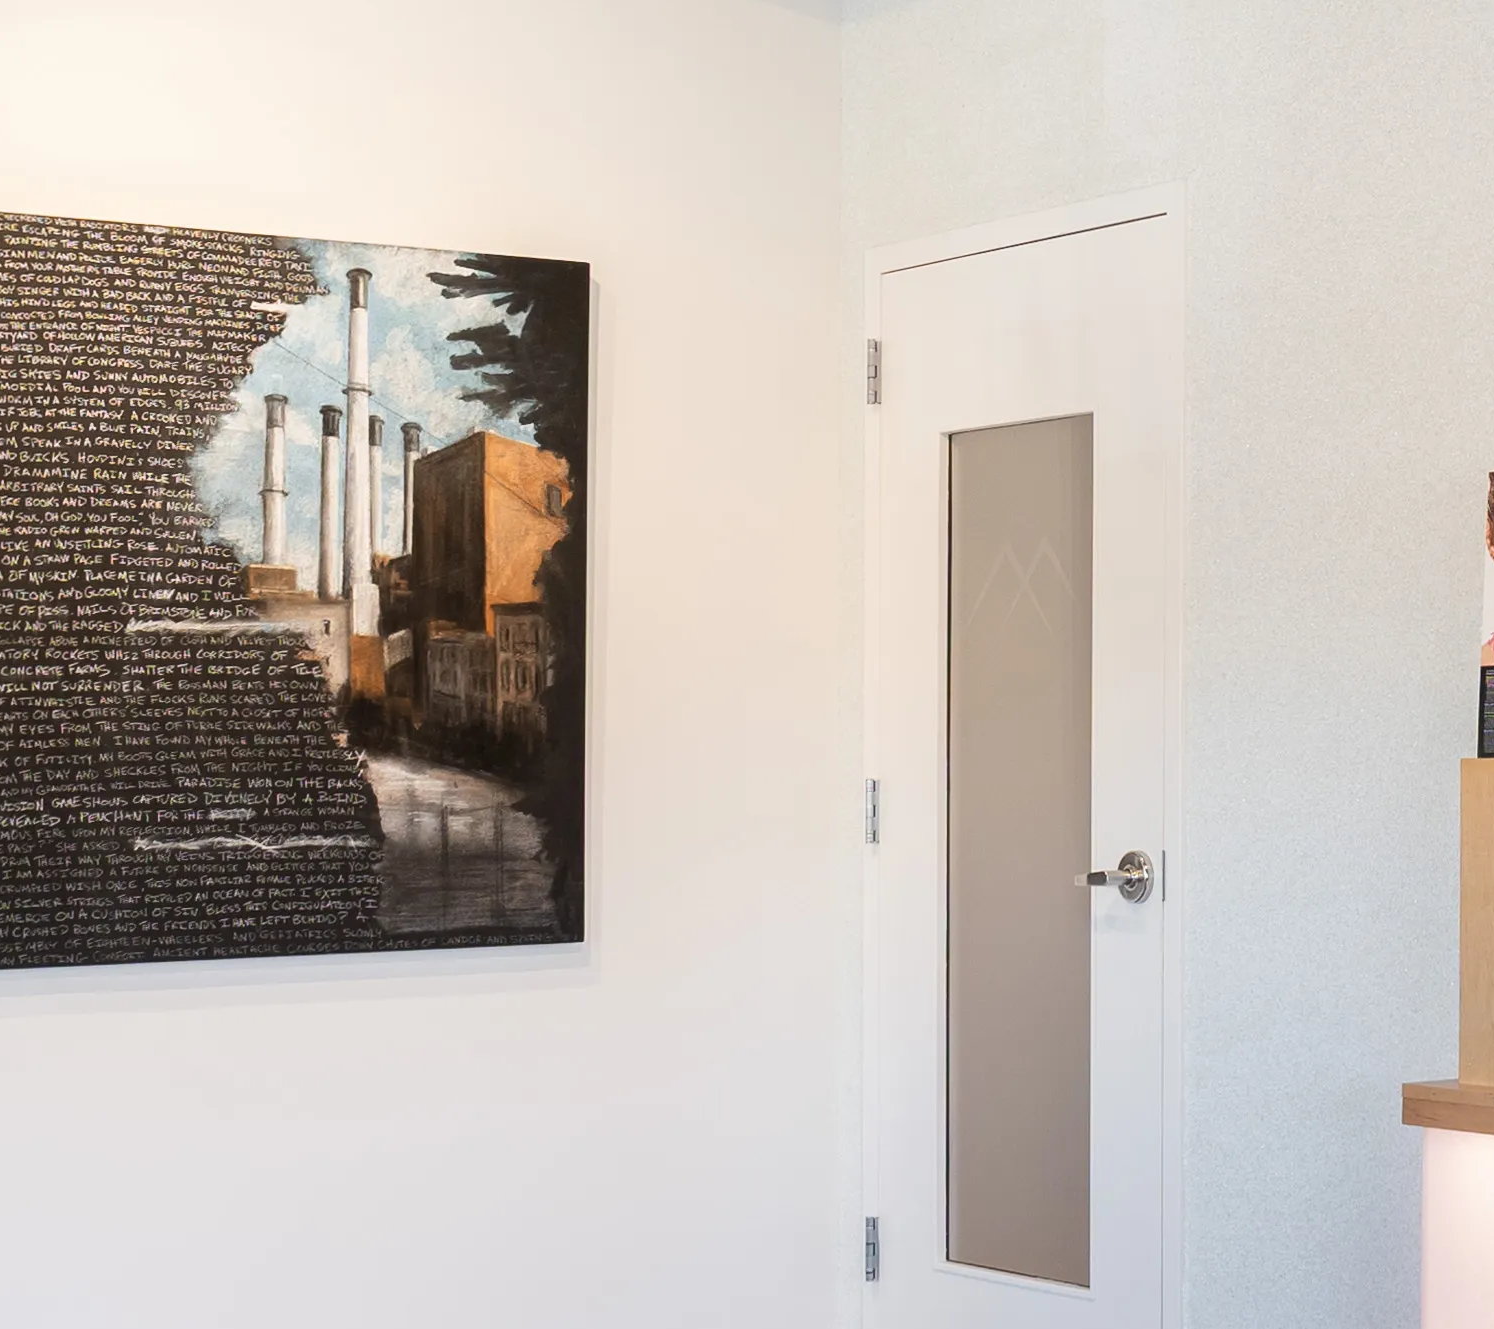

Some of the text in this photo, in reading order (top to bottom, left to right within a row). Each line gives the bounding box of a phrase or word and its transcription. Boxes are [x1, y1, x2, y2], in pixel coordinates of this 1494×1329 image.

[4, 234, 58, 248] PAINTING
[22, 223, 81, 238] ESCAPING
[85, 230, 105, 240] THE
[110, 233, 148, 245] BLOOM
[151, 236, 166, 247] OF
[174, 282, 206, 294] EGGS
[17, 354, 69, 366] LIBRARY
[71, 357, 85, 367] OF
[86, 358, 145, 370] CONGRESS
[149, 360, 180, 372] DARE
[182, 361, 203, 373] THE
[206, 365, 253, 375] SUGARY
[2, 464, 88, 480] DRAMAMINE
[93, 467, 127, 481] RAIN
[131, 470, 170, 484] WHILE
[171, 473, 192, 486] THE
[0, 481, 64, 494] ARBITRARY
[66, 483, 107, 495] SAINTS
[110, 483, 142, 494] SAIL
[1, 555, 20, 566] ON
[22, 555, 32, 566] A
[74, 554, 103, 565] PAGE
[109, 553, 174, 568] FIDGETED
[177, 558, 199, 569] AND
[58, 588, 83, 600] AND
[84, 585, 129, 599] GLOOMY
[176, 591, 199, 603] AND
[201, 590, 211, 602] I
[214, 591, 250, 602] WILL
[45, 648, 100, 660] ROCKETS
[141, 649, 191, 660] THROUGH
[196, 649, 266, 661] CORRIDORS
[270, 650, 289, 661] OF
[31, 680, 59, 691] NOT
[131, 792, 198, 805] CAPTURED
[204, 790, 271, 805] DIVINELY
[276, 791, 296, 805] BY
[303, 793, 313, 804] A
